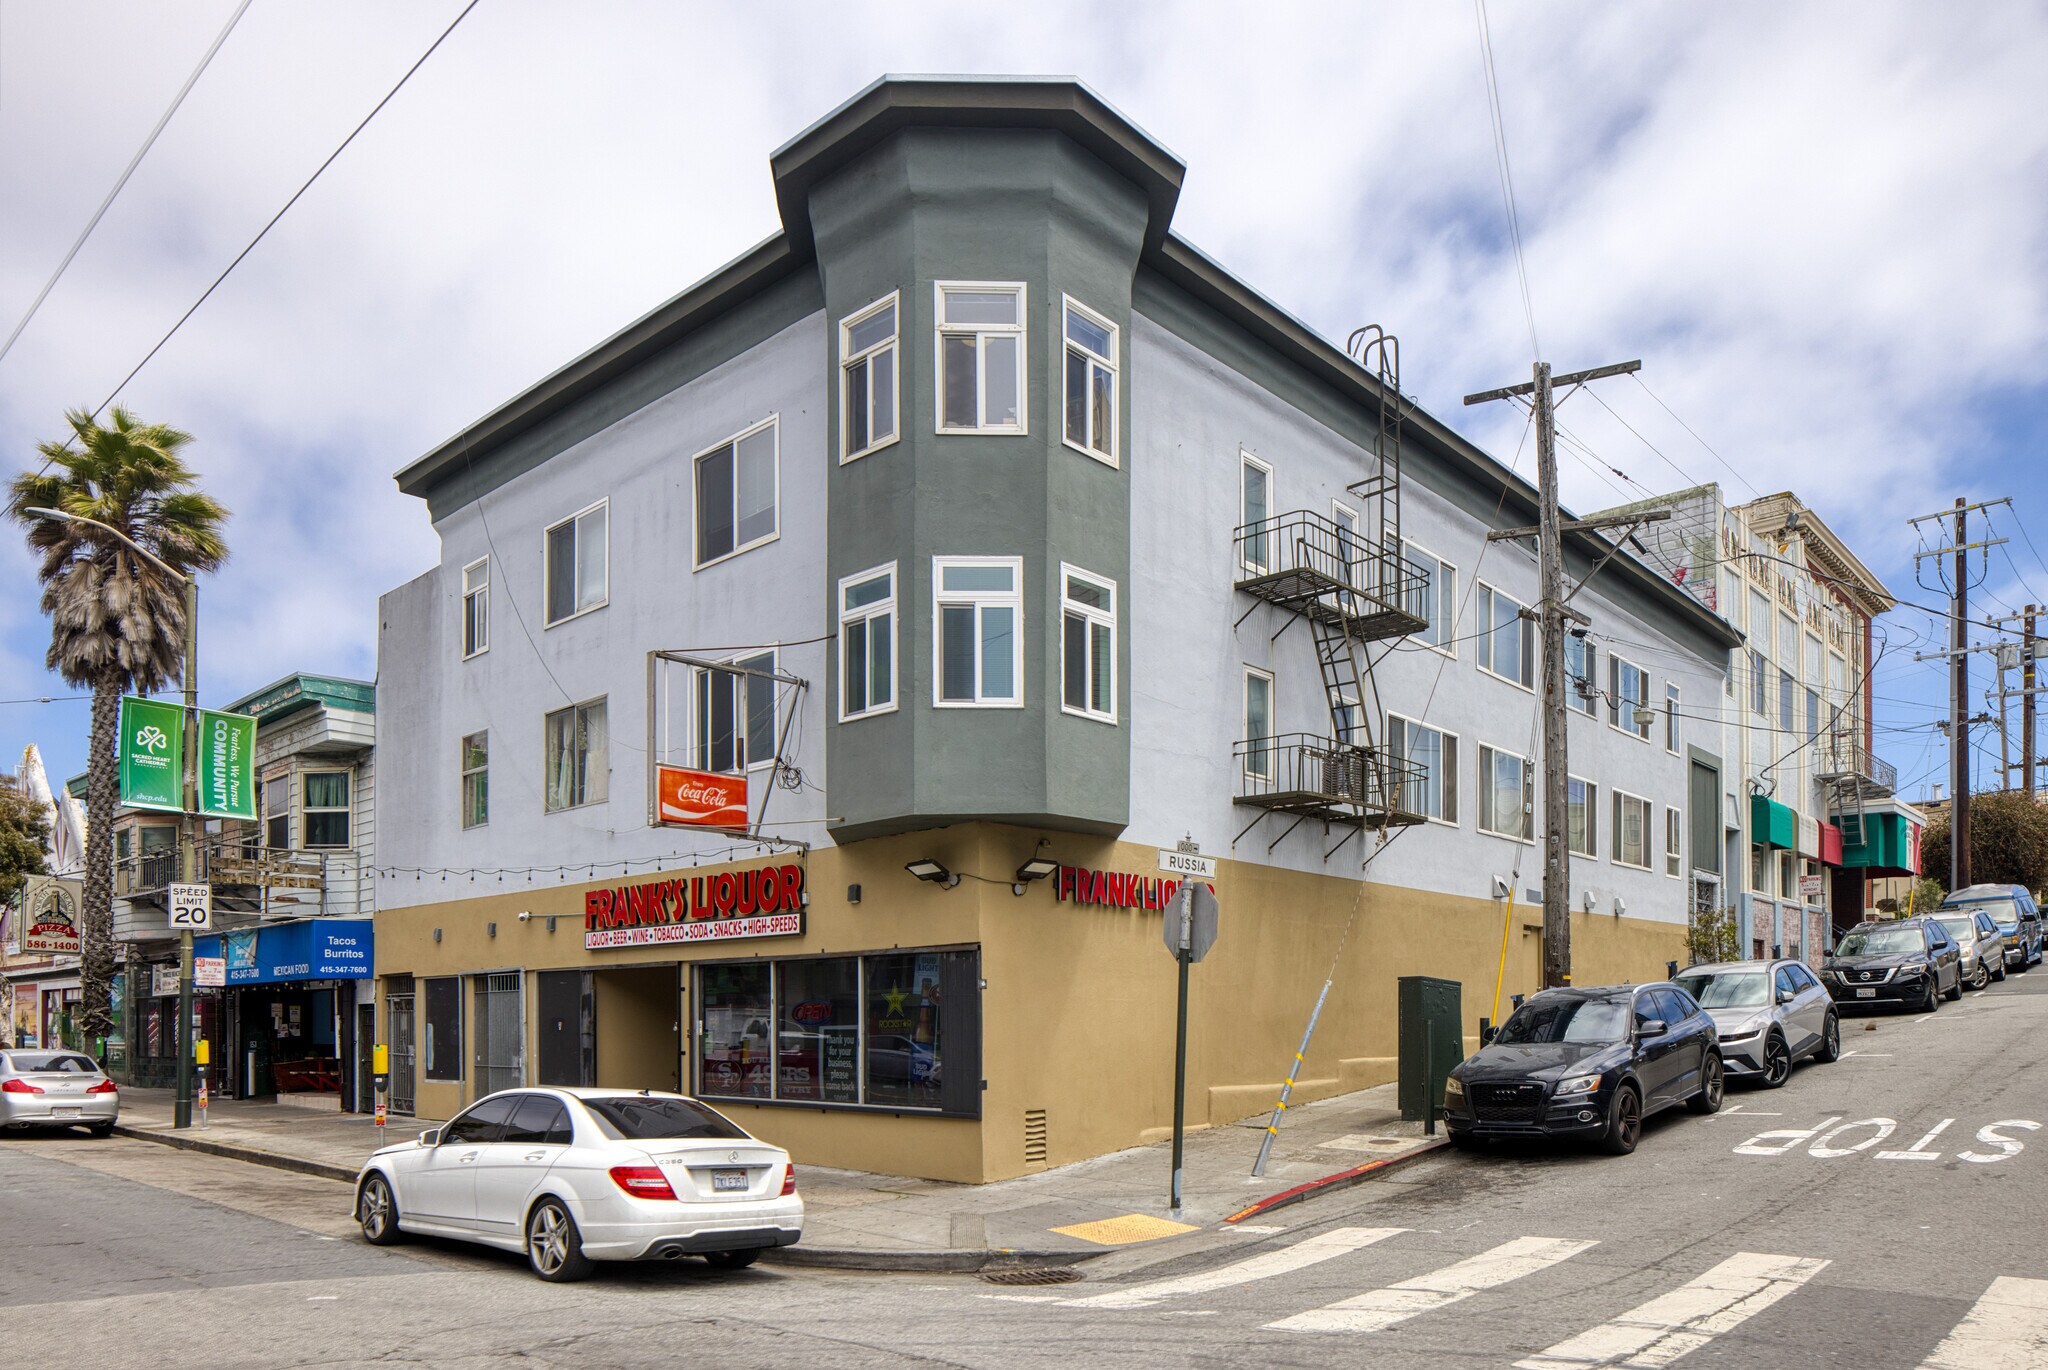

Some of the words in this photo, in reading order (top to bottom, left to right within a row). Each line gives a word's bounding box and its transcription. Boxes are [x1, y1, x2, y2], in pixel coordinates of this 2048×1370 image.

[229, 727, 241, 762] Fearless,
[135, 758, 167, 767] CATHEDRAL
[213, 719, 228, 811] COMMUNITY
[231, 765, 240, 778] We
[136, 793, 167, 803] shcp.edu
[230, 780, 240, 807] Pursue
[678, 783, 728, 807] Coca-Cola
[1169, 855, 1207, 873] RUSSIA
[173, 888, 208, 896] SPEED
[585, 878, 686, 930] FRANK'S
[690, 864, 802, 918] LIQUOR
[176, 897, 204, 905] LIMIT
[175, 907, 206, 924] 20
[37, 924, 71, 934] PIZZA
[587, 932, 610, 947] LIQUOR
[613, 930, 627, 944] BEER
[631, 928, 649, 943] WINE
[653, 924, 685, 941] TOBACCO
[689, 922, 709, 938] SODA
[713, 919, 743, 936] SNACKS
[747, 915, 798, 934] HIGH-SPEEDS
[328, 936, 356, 946] Tacos
[325, 949, 364, 959] Burritos
[921, 958, 937, 966] BUD
[230, 968, 260, 980] 415-347-7600
[273, 965, 295, 976] MEXICAN
[295, 963, 309, 973] FOOD
[918, 964, 939, 973] LIGHT
[793, 1004, 833, 1022] OPEN
[826, 1035, 843, 1043] Thank
[843, 1036, 855, 1045] you
[828, 1046, 838, 1055] for
[838, 1048, 852, 1057] your
[915, 1063, 927, 1071] BUD
[830, 1069, 849, 1080] please
[825, 1082, 842, 1090] come
[841, 1080, 855, 1090] back
[1733, 1116, 2043, 1163] STOP
